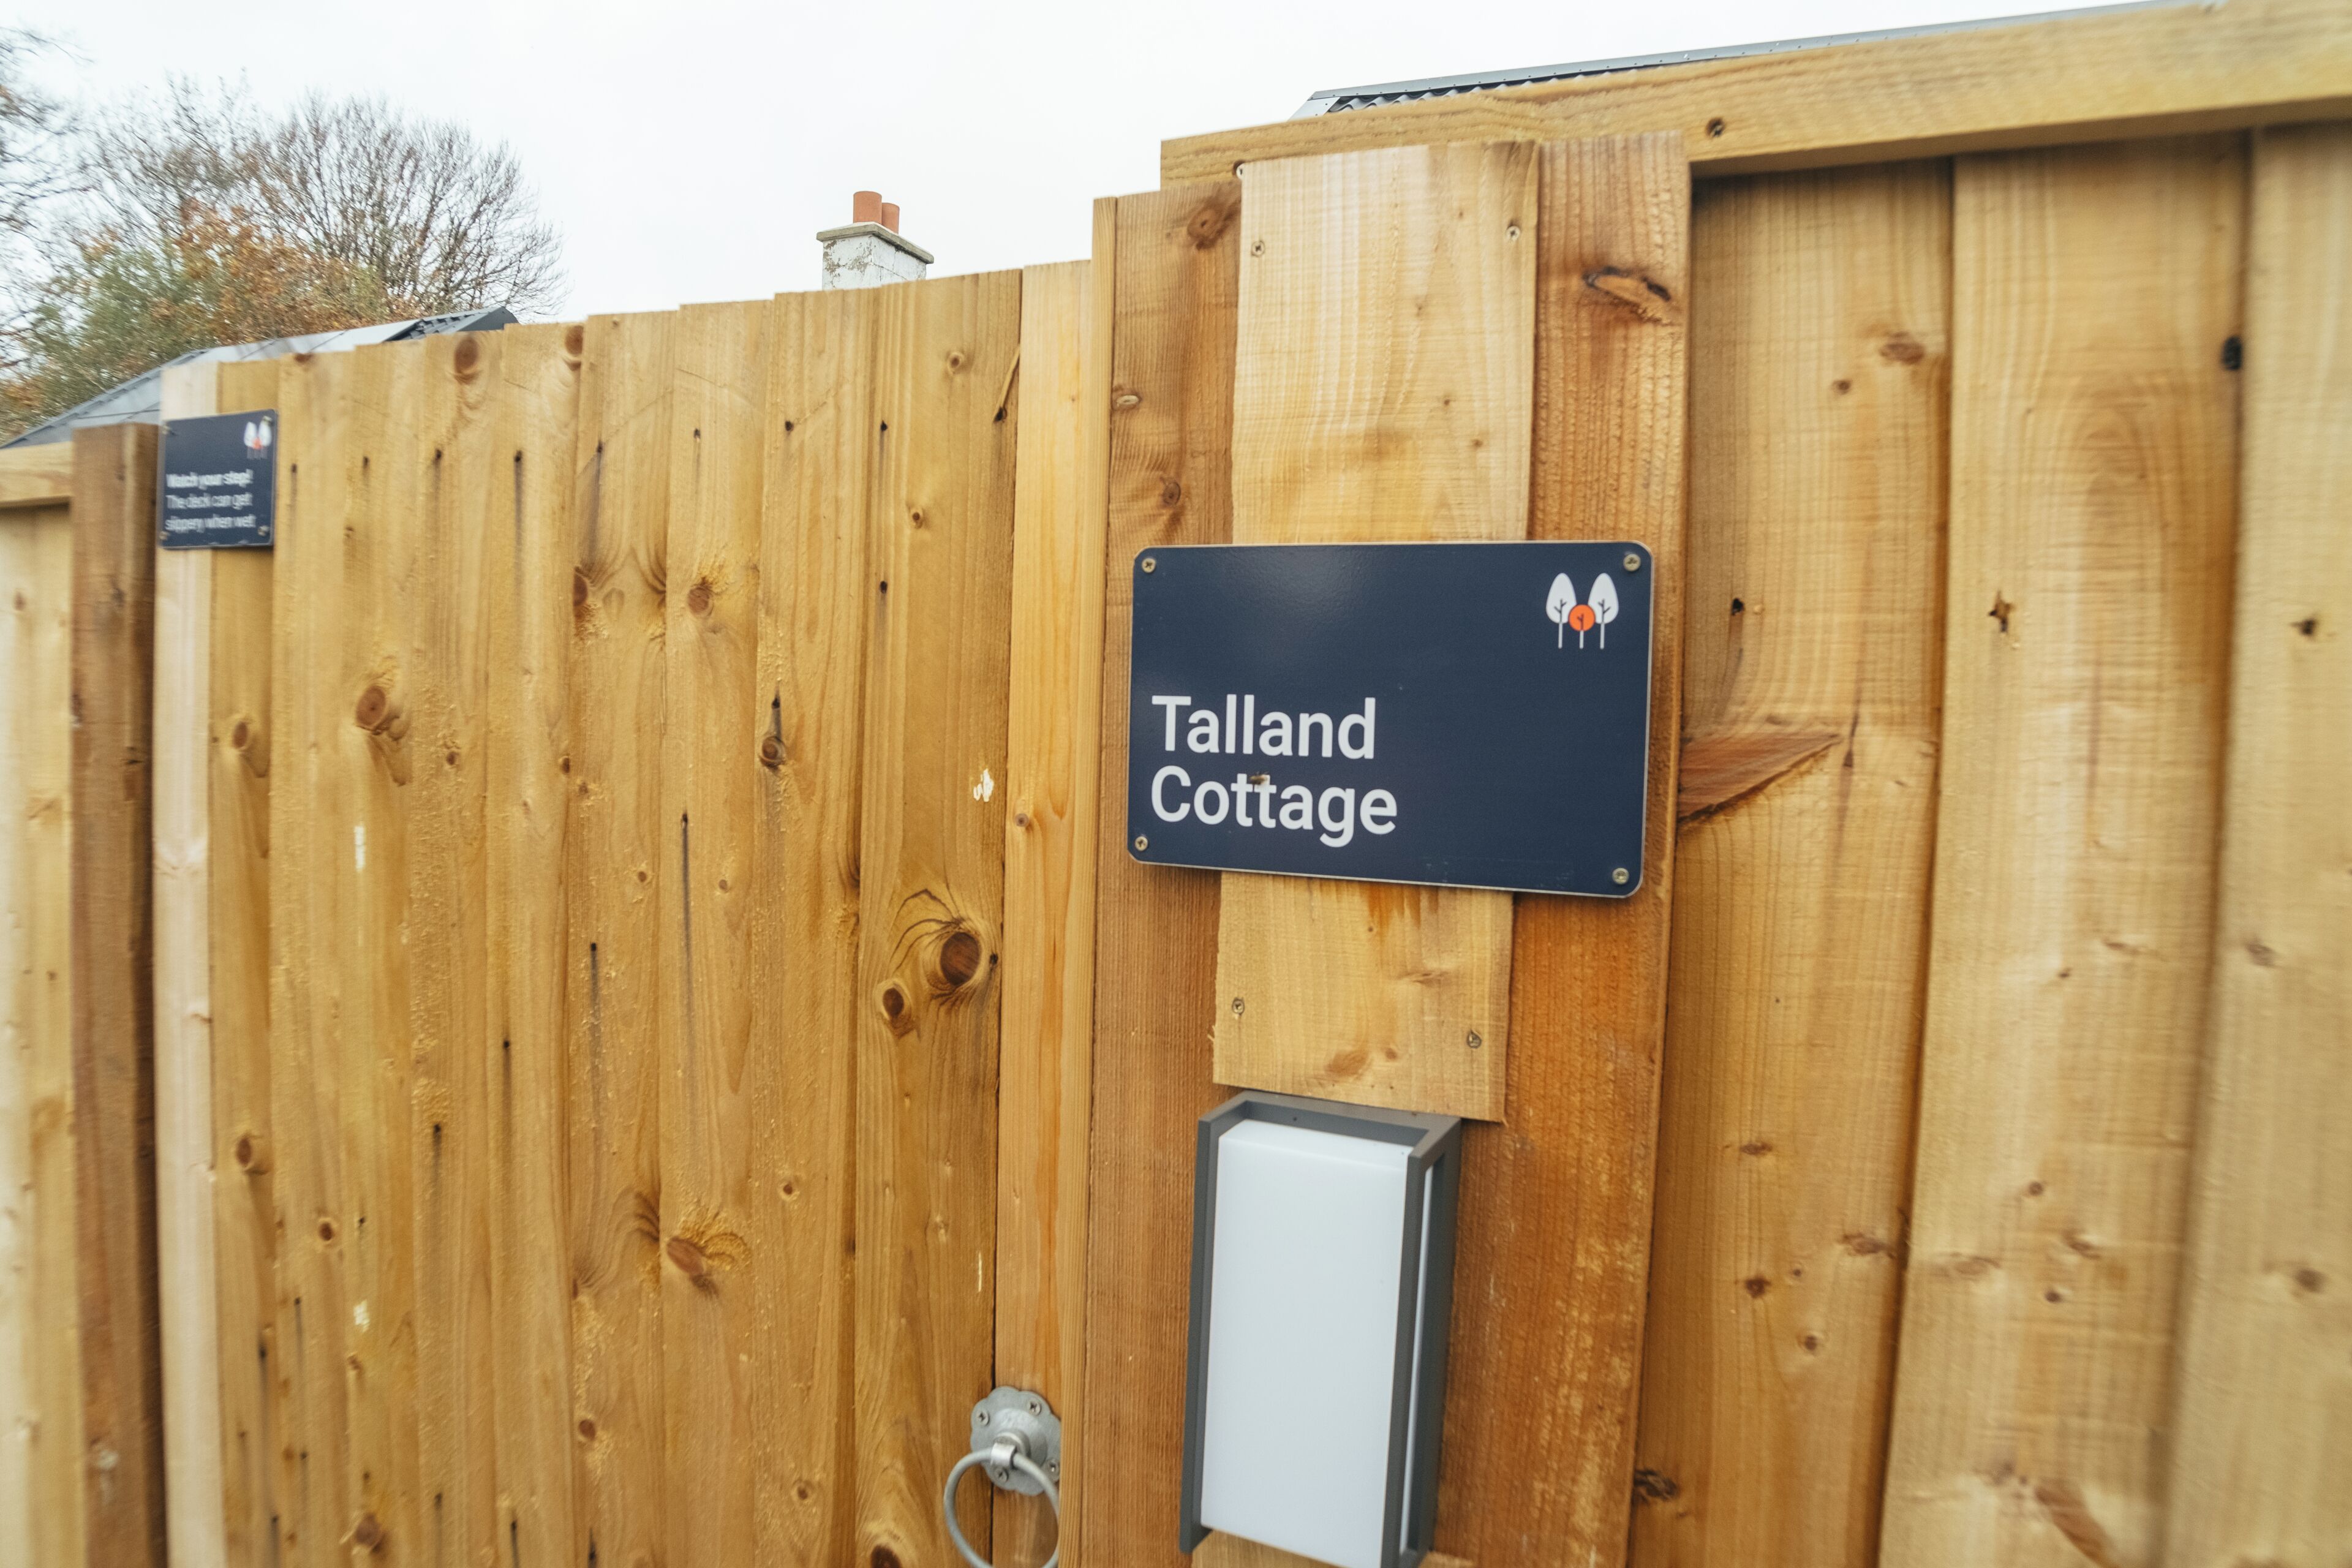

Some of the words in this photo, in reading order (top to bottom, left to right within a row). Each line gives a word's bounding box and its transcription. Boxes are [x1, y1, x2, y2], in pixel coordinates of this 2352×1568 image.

[198, 474, 223, 490] your
[165, 495, 187, 509] The
[211, 495, 232, 507] can
[232, 492, 252, 510] get
[165, 516, 205, 533] slippery
[204, 513, 233, 529] when
[1152, 693, 1376, 760] Talland
[1151, 766, 1397, 848] Cottage
